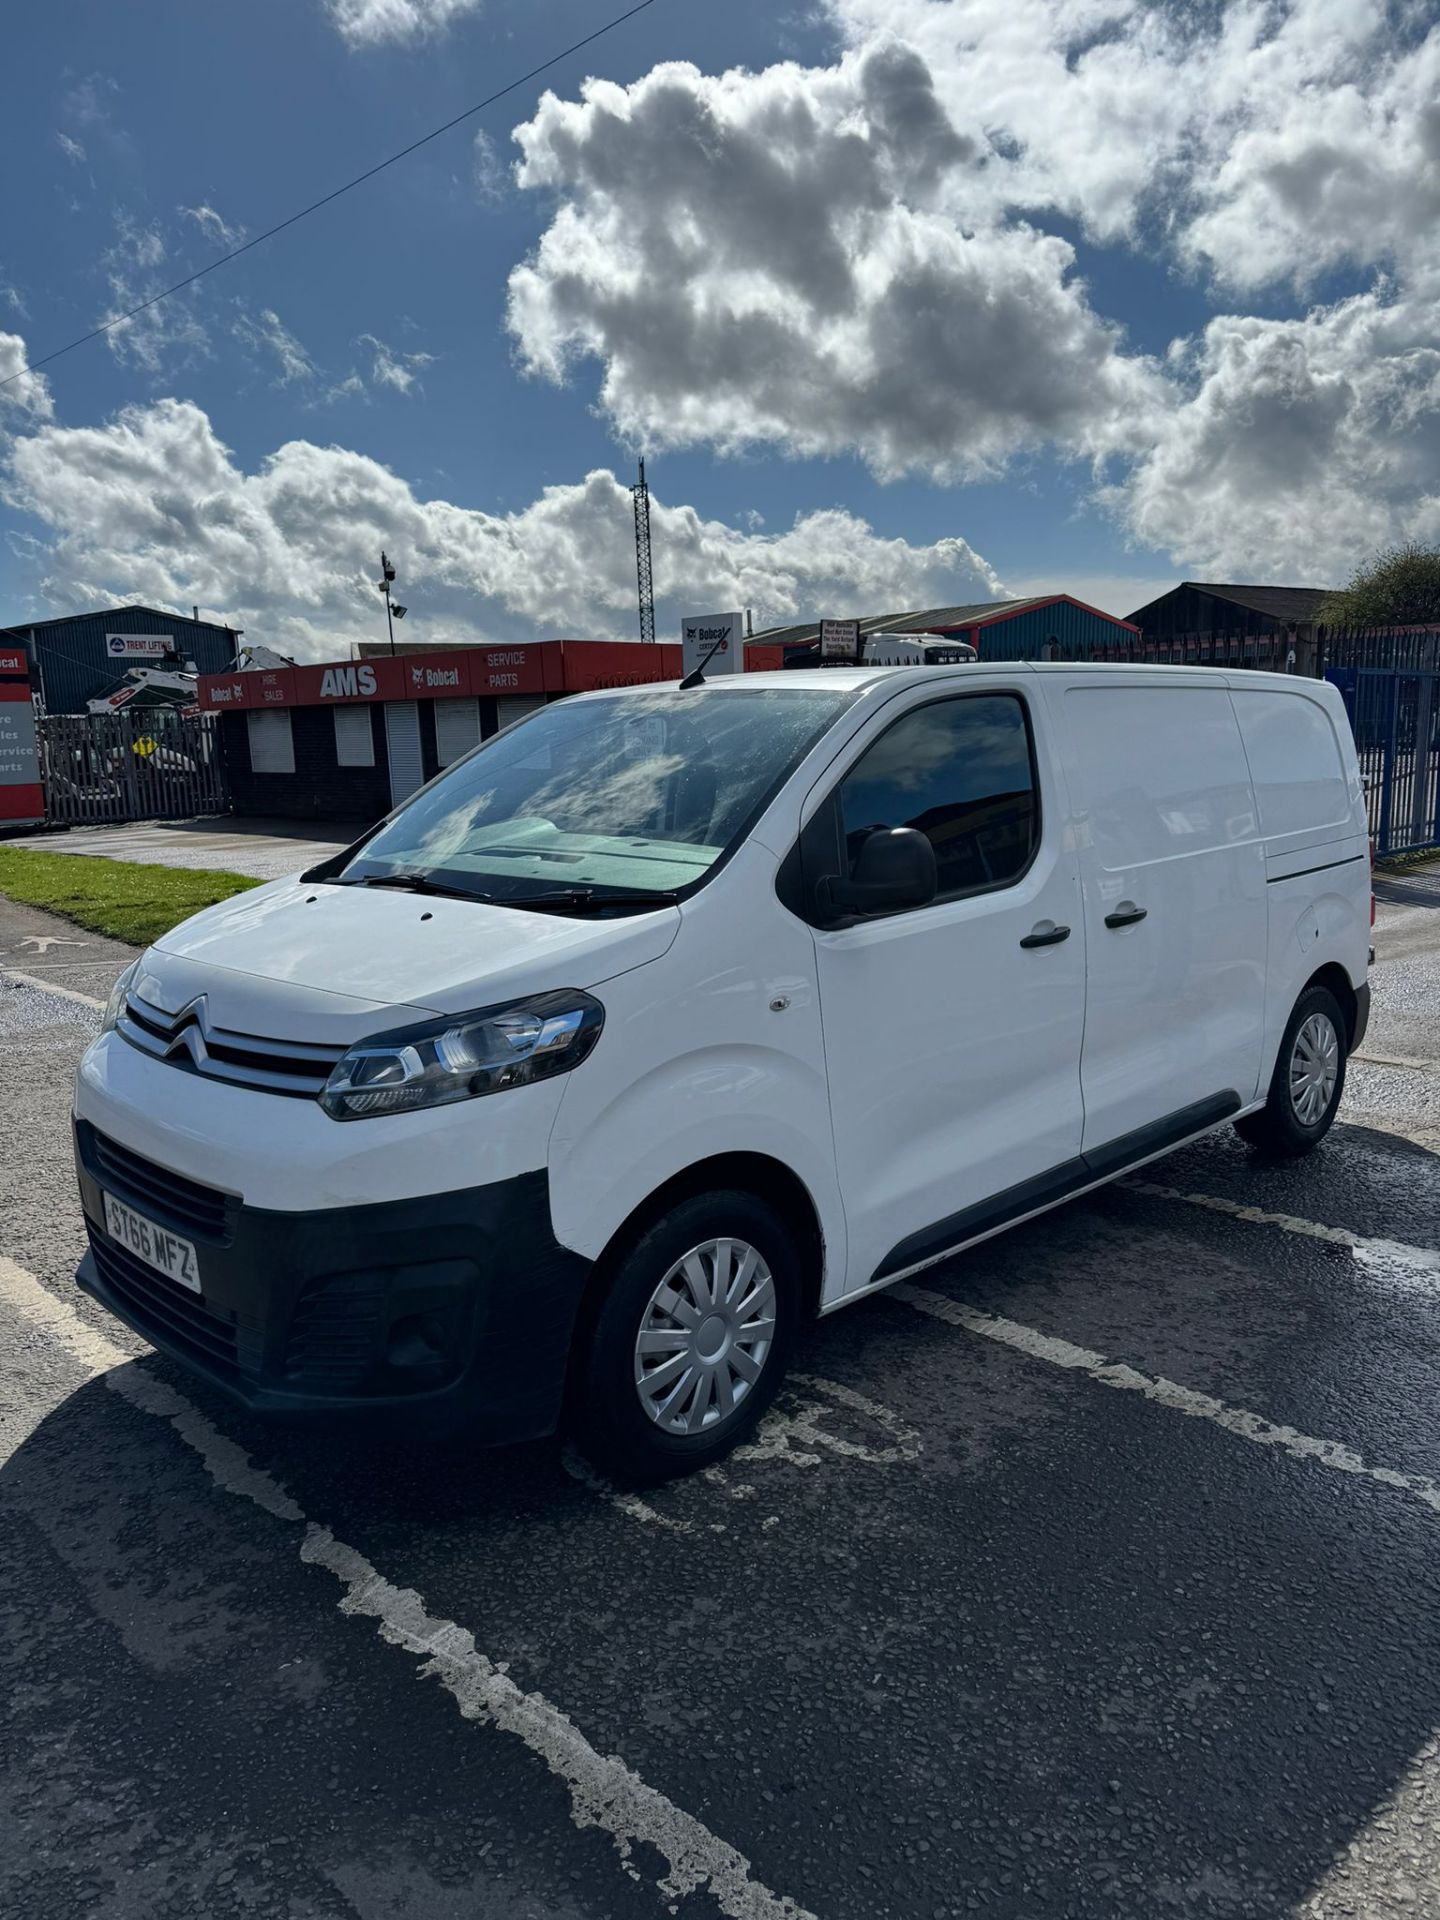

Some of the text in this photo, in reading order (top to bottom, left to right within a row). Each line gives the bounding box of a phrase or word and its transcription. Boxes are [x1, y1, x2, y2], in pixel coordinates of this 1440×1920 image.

[126, 640, 147, 650] TRENT
[487, 650, 526, 668] SERVICE
[262, 674, 277, 686] HIRE
[319, 664, 378, 698] AMS
[426, 667, 460, 687] Bobcat
[489, 672, 519, 687] PARTS
[210, 687, 232, 702] Bobcat
[264, 689, 284, 702] SALES
[110, 1201, 194, 1283] ST66 MFZ
